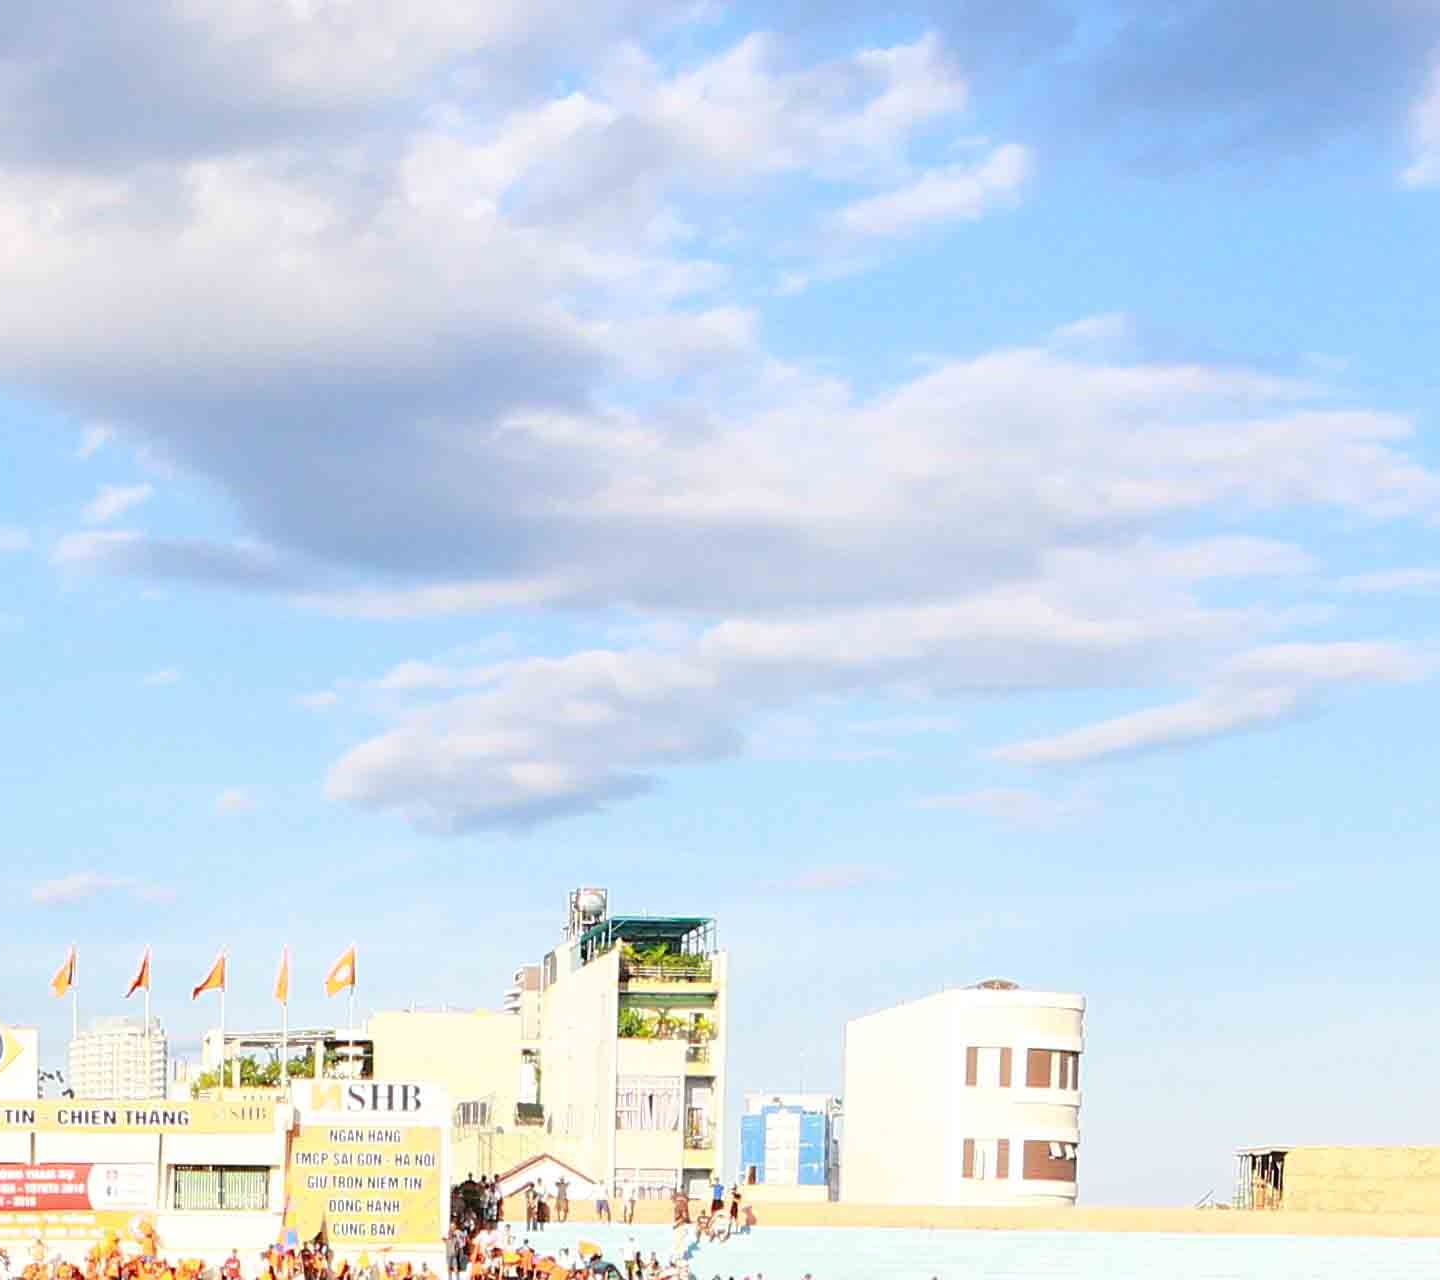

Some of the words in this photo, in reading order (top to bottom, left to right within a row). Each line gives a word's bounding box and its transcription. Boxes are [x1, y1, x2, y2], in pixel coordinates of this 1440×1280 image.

[347, 1084, 422, 1111] SHB
[5, 1109, 36, 1125] TIN
[403, 1176, 423, 1189] TIN
